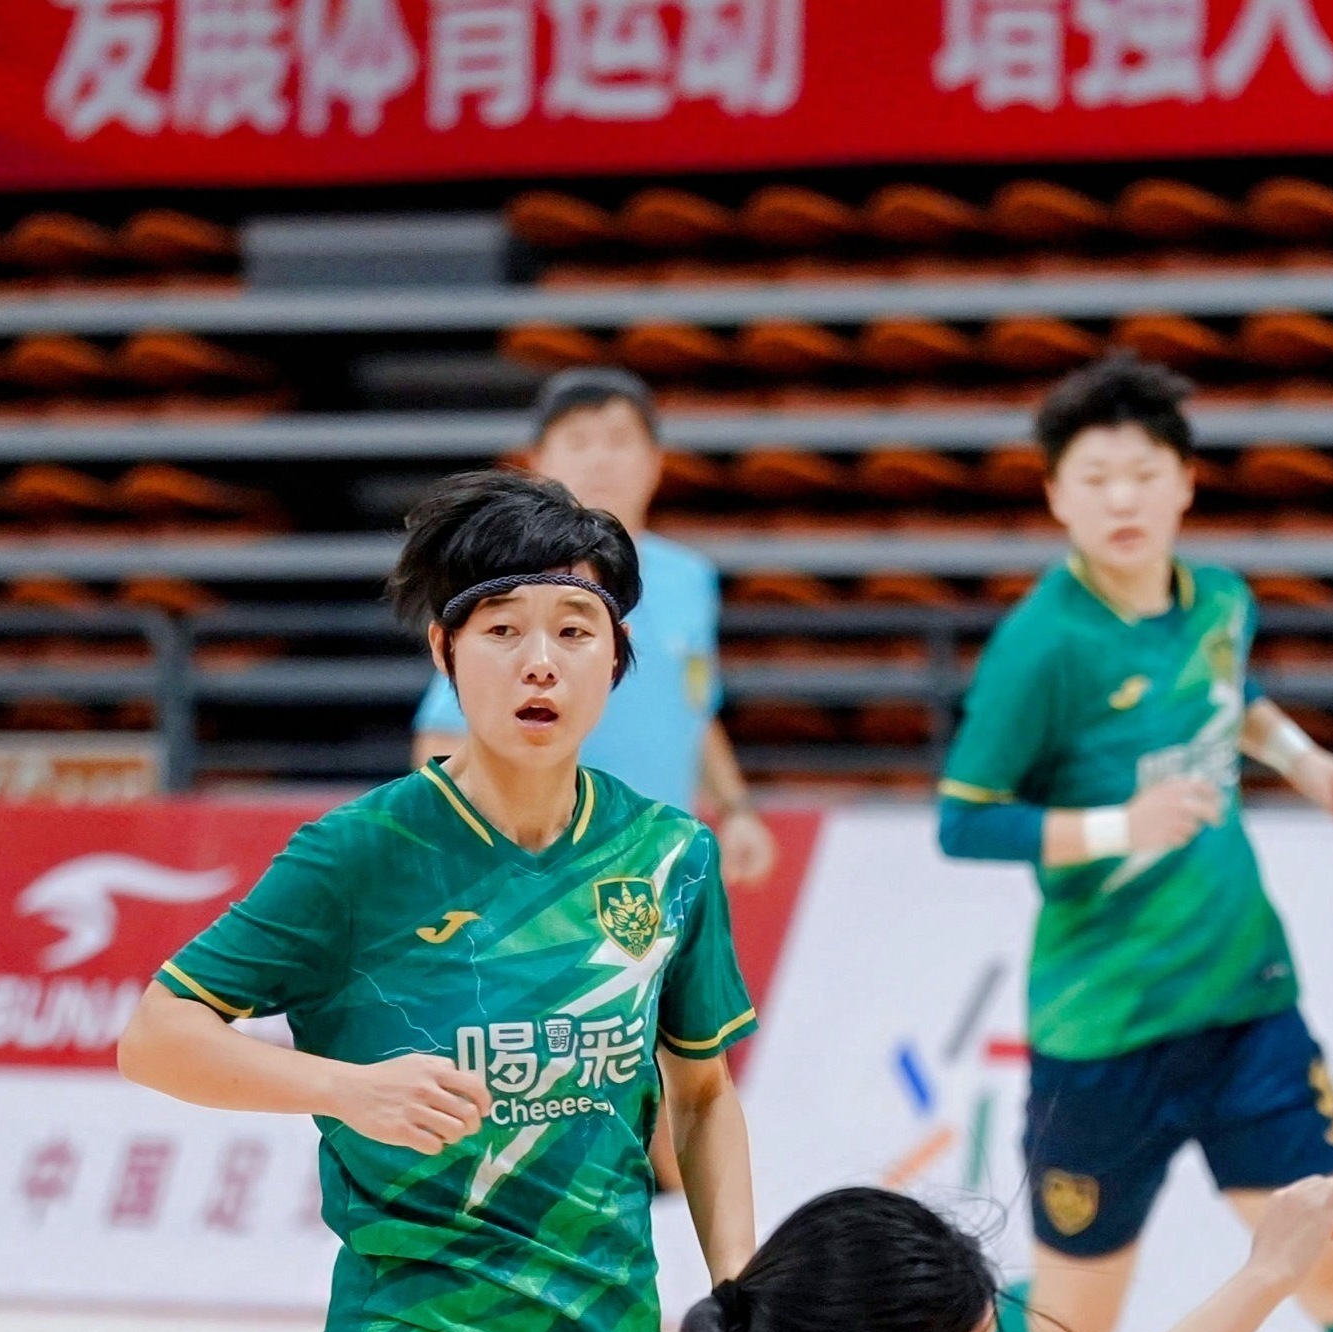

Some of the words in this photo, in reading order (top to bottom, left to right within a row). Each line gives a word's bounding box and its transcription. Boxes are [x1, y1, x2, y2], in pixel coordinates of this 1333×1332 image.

[45, 0, 806, 140] 发展体育运动
